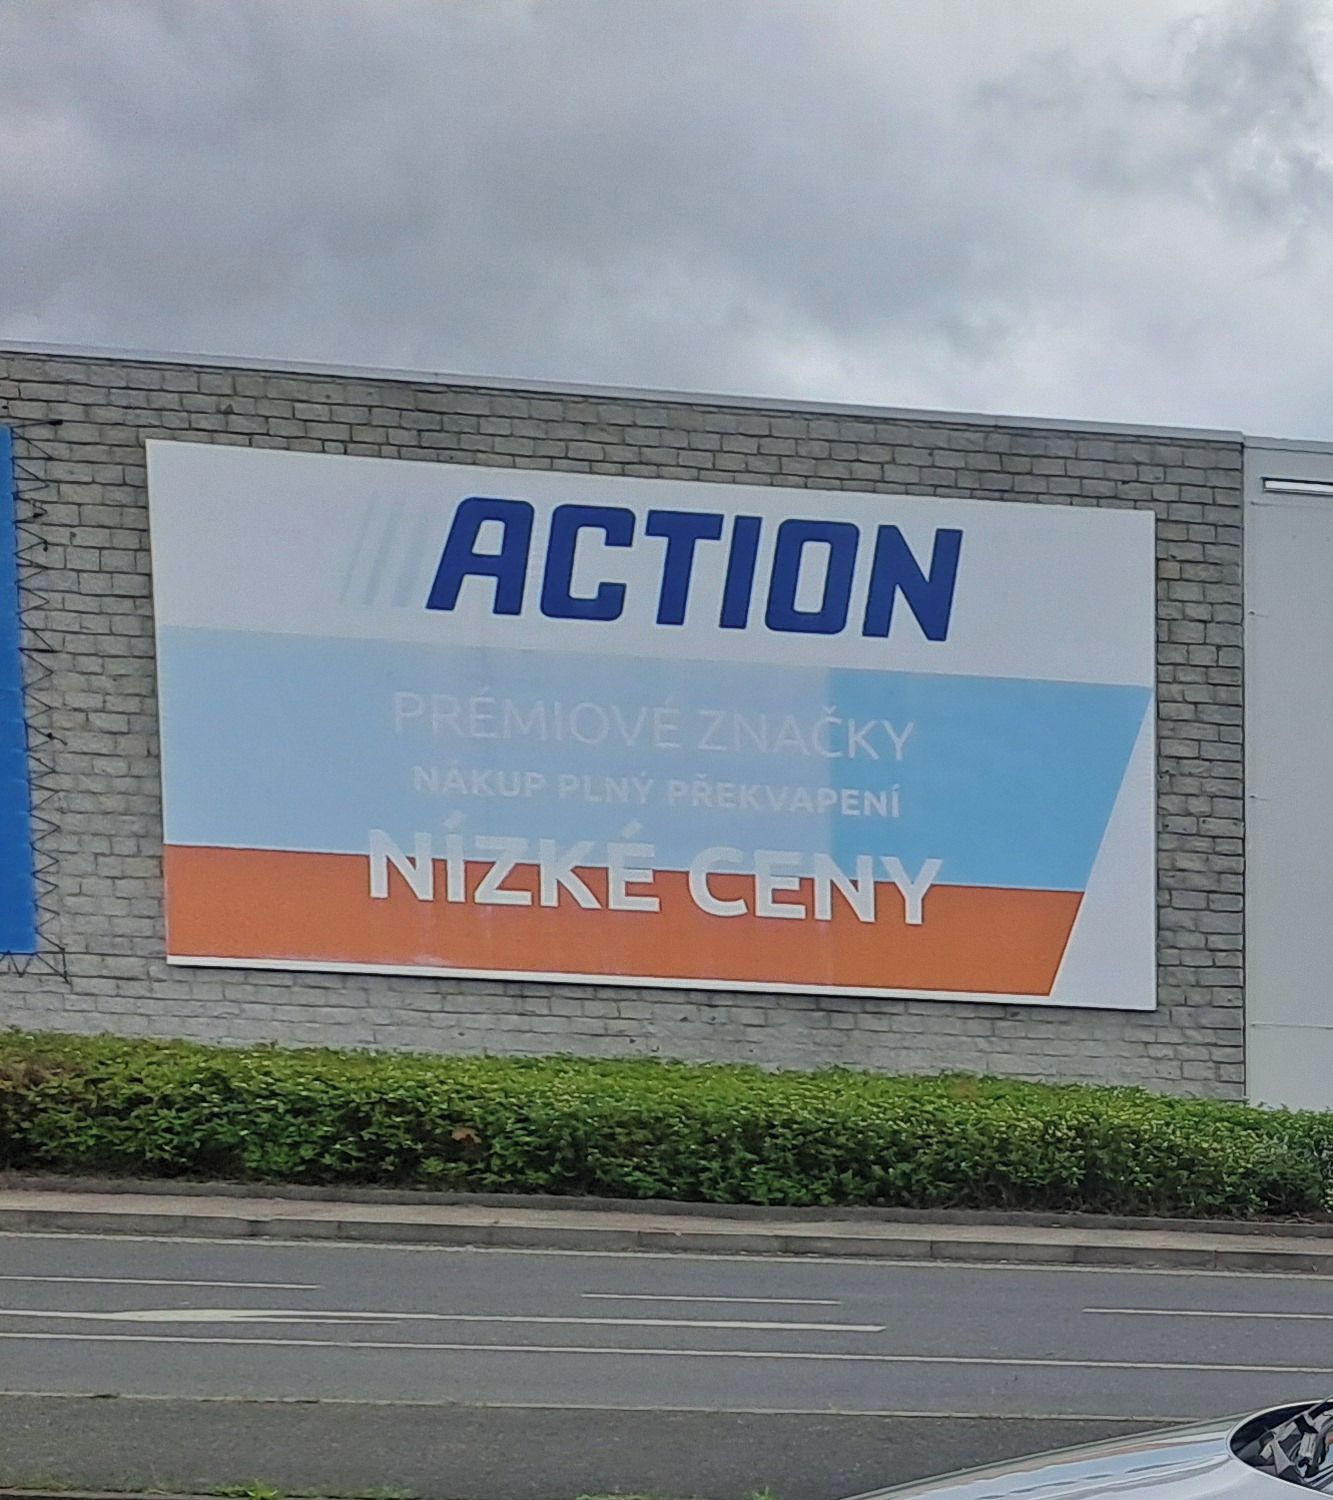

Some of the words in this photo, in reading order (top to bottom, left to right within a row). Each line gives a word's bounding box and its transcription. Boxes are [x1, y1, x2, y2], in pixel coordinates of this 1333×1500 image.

[427, 495, 964, 642] ACTION
[393, 686, 681, 748] PRÉMIOVÉ
[698, 705, 915, 762] ZNAČKY
[412, 759, 547, 799] NÁKUP
[557, 770, 654, 805] PLNÝ
[668, 773, 901, 818] PŘEKVAPENÍ
[367, 810, 660, 913] NÍZKÉ
[688, 846, 944, 926] CENY
